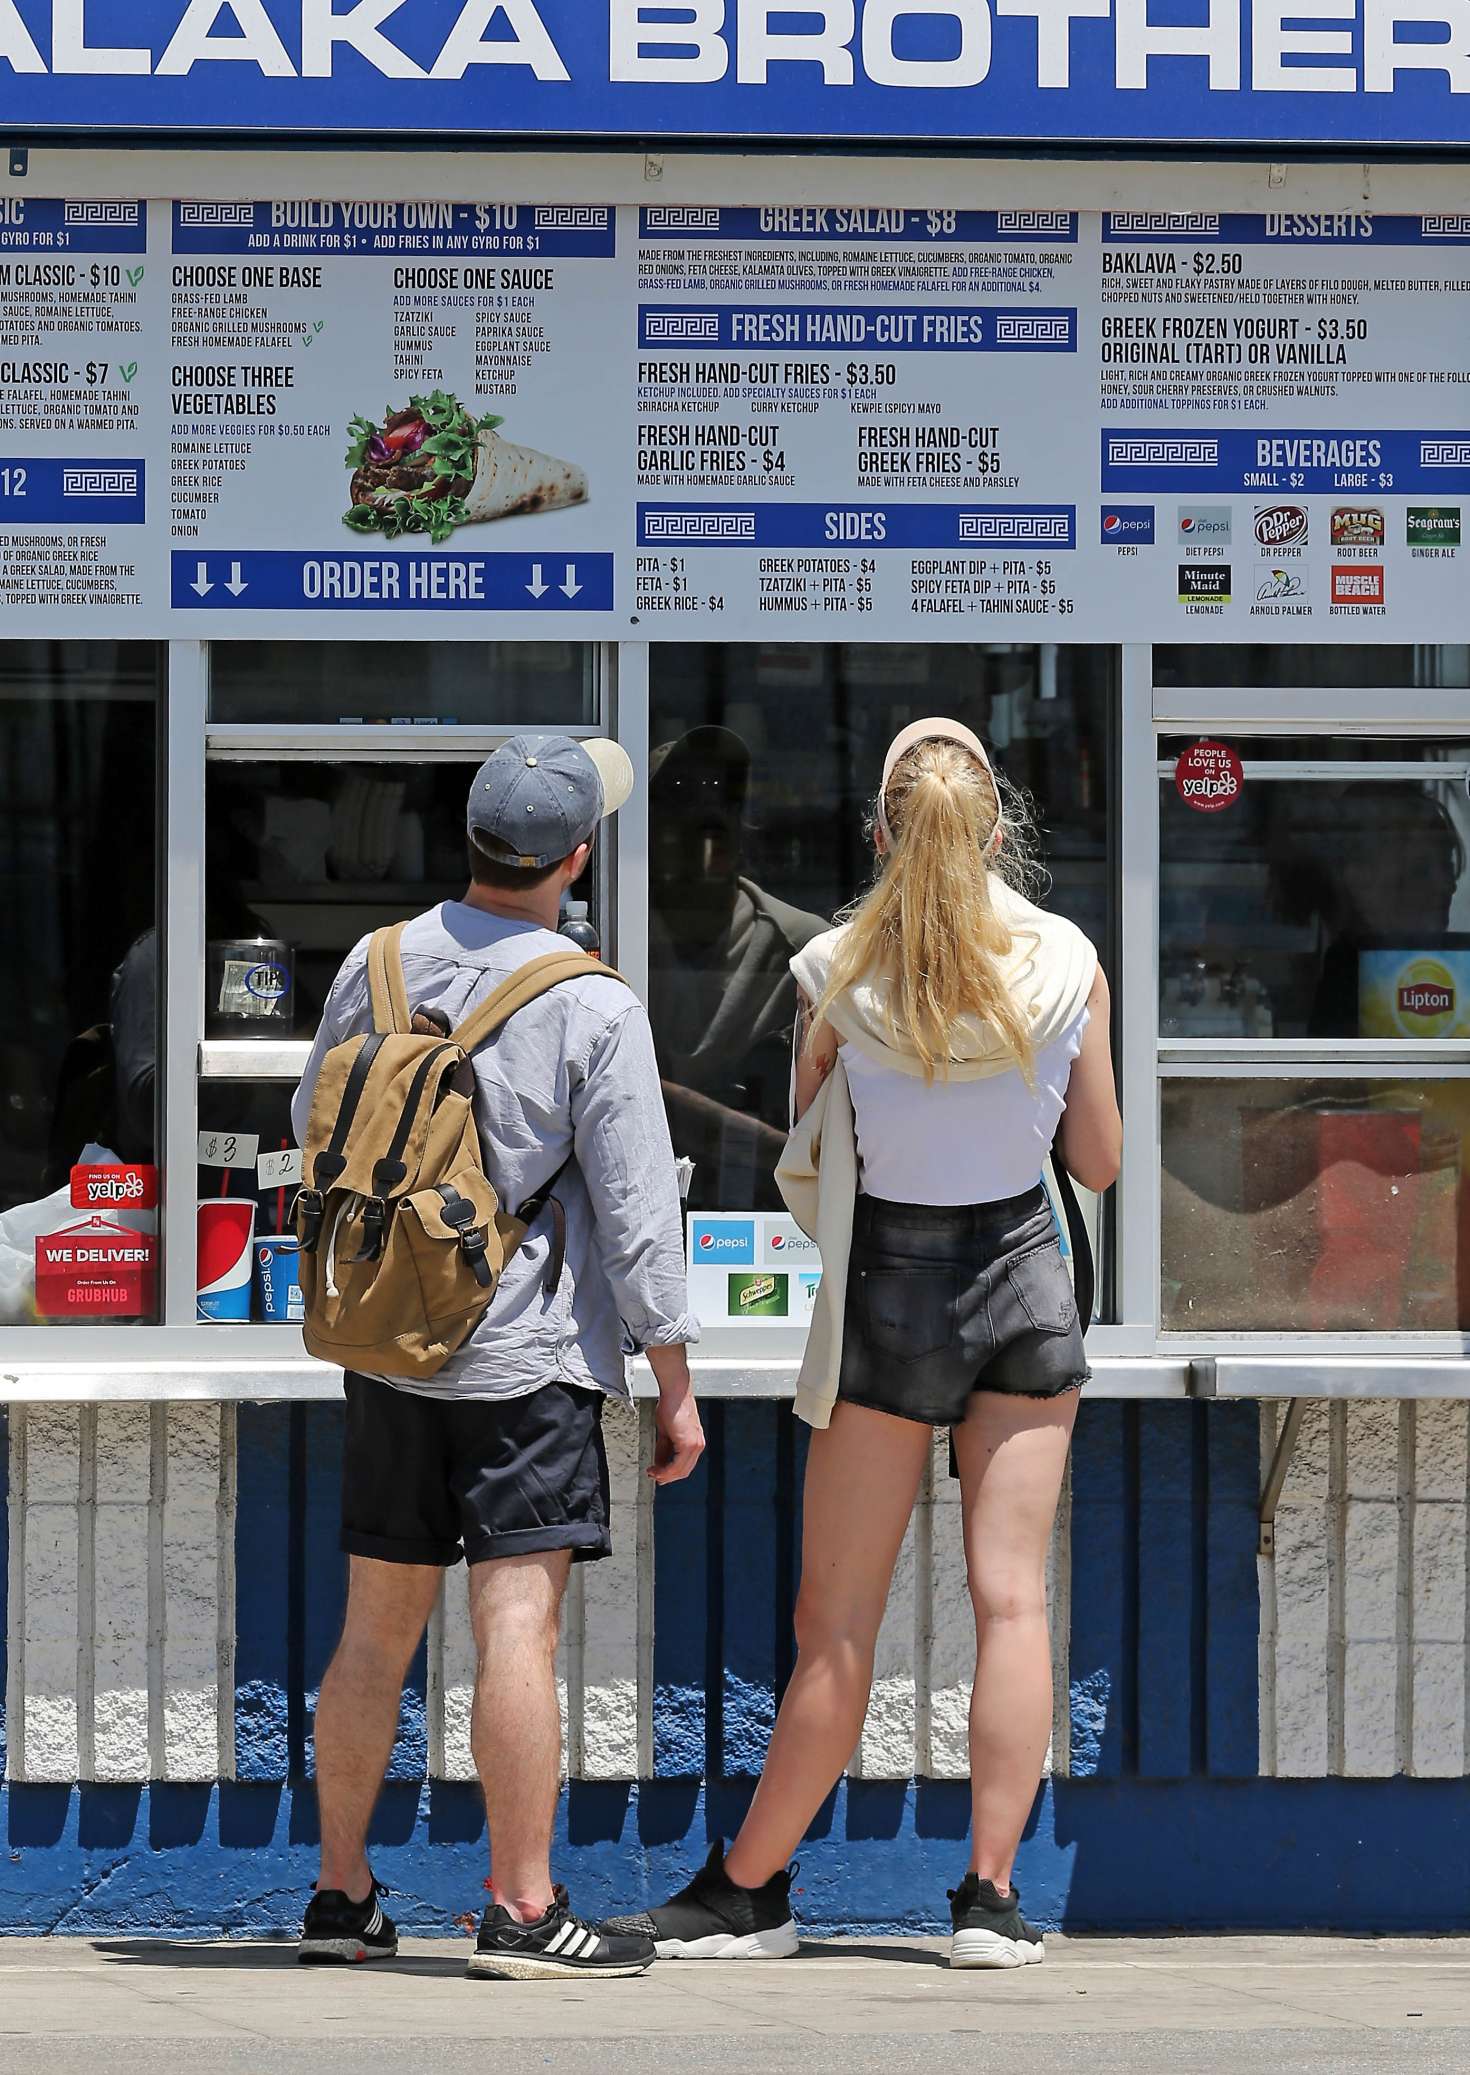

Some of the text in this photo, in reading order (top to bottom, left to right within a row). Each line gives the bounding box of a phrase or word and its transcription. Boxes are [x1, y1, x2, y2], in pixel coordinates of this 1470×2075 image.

[609, 0, 1470, 93] BROTHER
[271, 202, 333, 228] BUILD
[340, 202, 396, 229] YOUR
[403, 203, 453, 229] OWN
[475, 203, 517, 233] $10
[760, 208, 829, 233] GREEK
[835, 208, 905, 234] SALAD
[926, 209, 957, 237] $8
[1265, 214, 1373, 238] DESSERTS
[2, 232, 69, 246] GYRO FOR $1
[248, 234, 356, 249] ADD A DRINK FOR $1
[374, 235, 539, 250] ADD FRIES IN ANY GYRO FOR $1
[1103, 253, 1176, 273] BAKLAVA
[1193, 252, 1242, 276] $2.50
[173, 266, 322, 288] CHOOSE ONE BASE
[394, 268, 553, 290] CHOOSE ONE SAUCE
[1, 292, 136, 304] MUSHROOMS, HOMEMADE TAHINI
[172, 293, 247, 304] GRASS-FED LAMB
[172, 306, 267, 318] FREE-RANGE CHICKEN
[394, 312, 432, 322] TZATZIKI
[476, 311, 531, 323] SPICY SAUCE
[172, 322, 306, 333] ORGANIC GRILLED MUSHROOMS
[394, 326, 456, 336] GARLIC SAUCE
[476, 327, 544, 337] PAPRIKA SAUCE
[732, 314, 982, 343] FRESH HAND-CUT FRIES
[1102, 317, 1156, 338] GREEK
[1163, 318, 1227, 338] FROZEN
[1233, 318, 1299, 339] YOGURT
[1318, 318, 1367, 340] $3.50
[171, 336, 293, 348] FRESH HOMEMADE FALAFEL
[394, 340, 432, 351] HUMMUS
[476, 341, 551, 352] EGGPLANT SAUCE
[1102, 342, 1346, 364] ORIGINAL (TART) OR VANILLA
[394, 354, 422, 365] TAHINI
[476, 355, 532, 366] MAYONNAISE
[1, 362, 68, 383] CLASSIC
[86, 361, 108, 386] $7
[172, 366, 294, 387] CHOOSE THREE
[394, 369, 443, 380] SPICY FETA
[172, 394, 276, 415] VEGETABLES
[638, 425, 779, 446] FRESH HAND-CUT
[171, 443, 251, 454] ROMAINE LETTUCE
[1258, 440, 1380, 467] BEVERAGES
[171, 459, 245, 470] GREEK POTATOES
[638, 450, 695, 471] GARLIC
[701, 450, 745, 471] FRIES
[763, 449, 785, 474] $4
[172, 476, 222, 487] GREEK RICE
[172, 492, 218, 503] CUCUMBER
[171, 509, 206, 519] TOMATO
[1273, 511, 1291, 527] Dr
[825, 512, 885, 539] SIDES
[1122, 519, 1151, 531] pepsi
[1197, 520, 1229, 534] pepsi
[1262, 514, 1303, 542] Pepper
[1334, 513, 1383, 531] MUG
[1407, 515, 1461, 531] Seagram's
[172, 525, 198, 536] ONION
[1118, 547, 1137, 556] PEPSI
[1186, 547, 1223, 556] DIET PEPSI
[1261, 548, 1301, 557] DR PEPPER
[1337, 548, 1377, 557] ROOT BEER
[1412, 548, 1455, 558] GINGER ALE
[304, 561, 485, 598] ORDER HERE
[1184, 570, 1227, 581] Minute
[1335, 575, 1380, 585] MUSCLE
[1190, 580, 1221, 591] Maid
[1335, 584, 1380, 596] BEACH
[1186, 605, 1223, 614] LEMONADE
[1250, 606, 1312, 615] ARNOLD PALMER
[1330, 606, 1385, 615] BOTTLED WATER
[1194, 749, 1227, 758] PEOPLE
[1188, 757, 1232, 769] LOVE US
[1183, 777, 1220, 798] yelp
[1403, 990, 1449, 1009] Lipton
[88, 1182, 126, 1202] yelp
[716, 1237, 748, 1249] pepsi
[787, 1240, 816, 1251] peps
[46, 1249, 150, 1262] WE DELIVER!
[67, 1288, 128, 1302] GRUBHUB
[264, 1266, 277, 1314] pepsi
